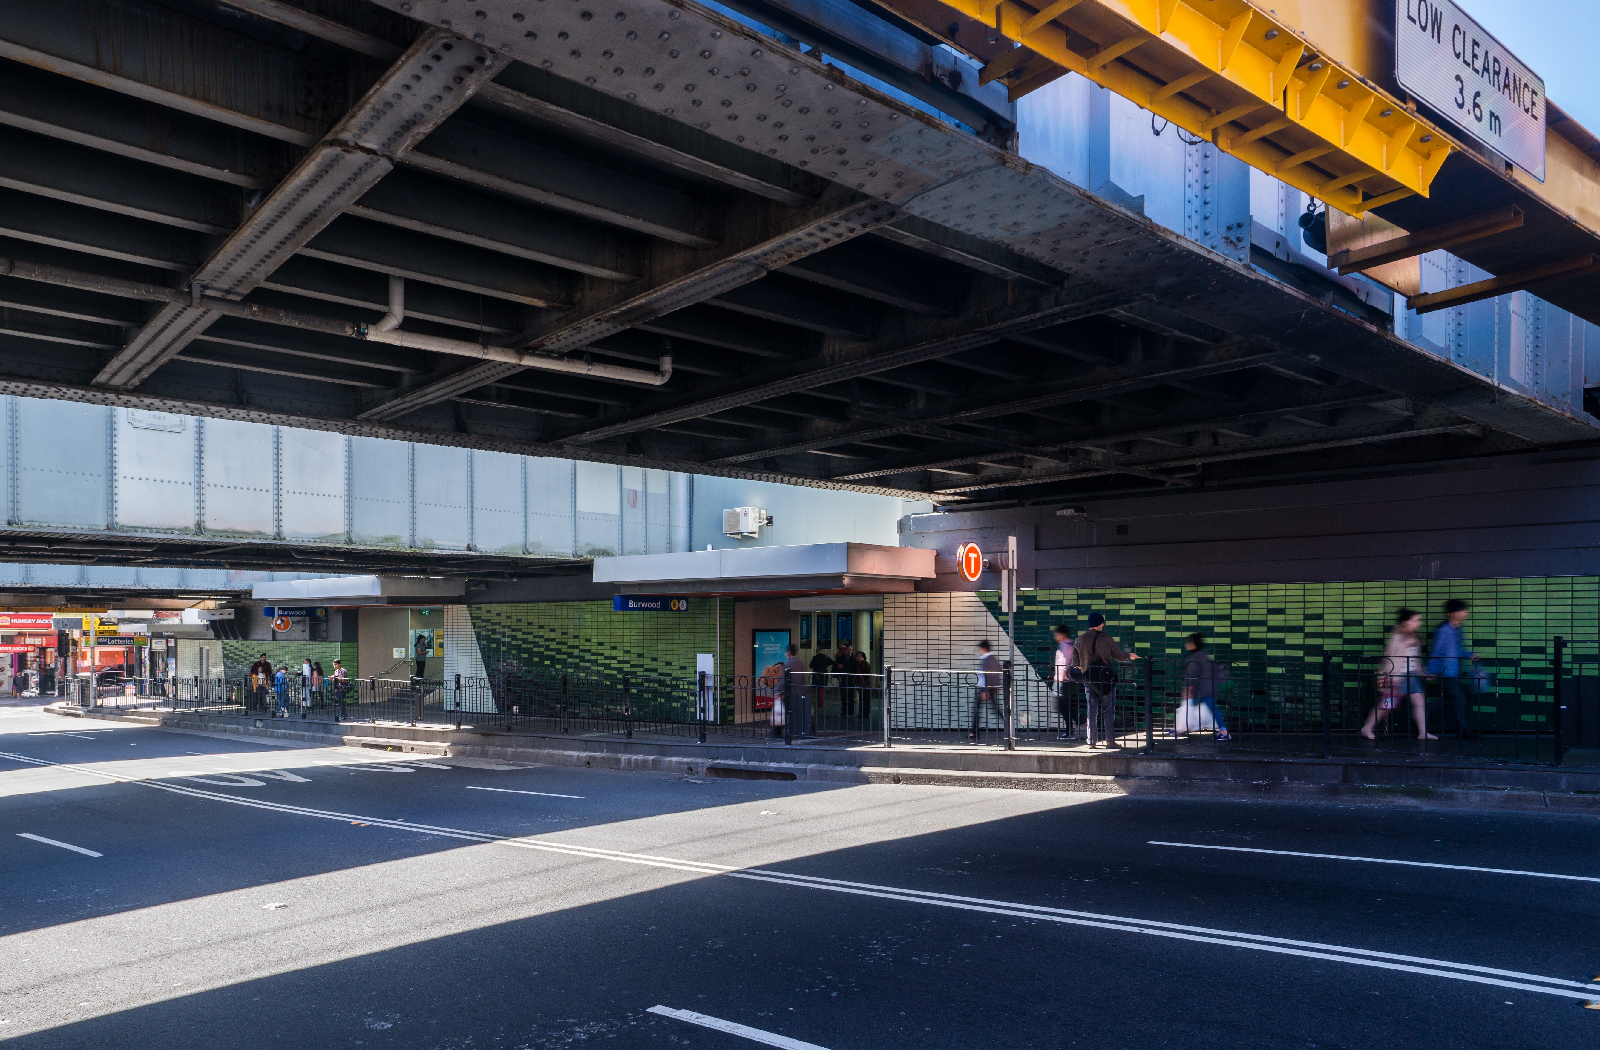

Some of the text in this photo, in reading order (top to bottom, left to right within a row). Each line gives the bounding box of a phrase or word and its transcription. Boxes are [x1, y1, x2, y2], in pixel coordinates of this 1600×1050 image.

[1407, 0, 1538, 121] LOW CLEARANCE
[1454, 74, 1502, 138] 3.6 m
[968, 552, 978, 574] T
[628, 599, 661, 609] Burwood
[107, 637, 134, 645] Lotteries
